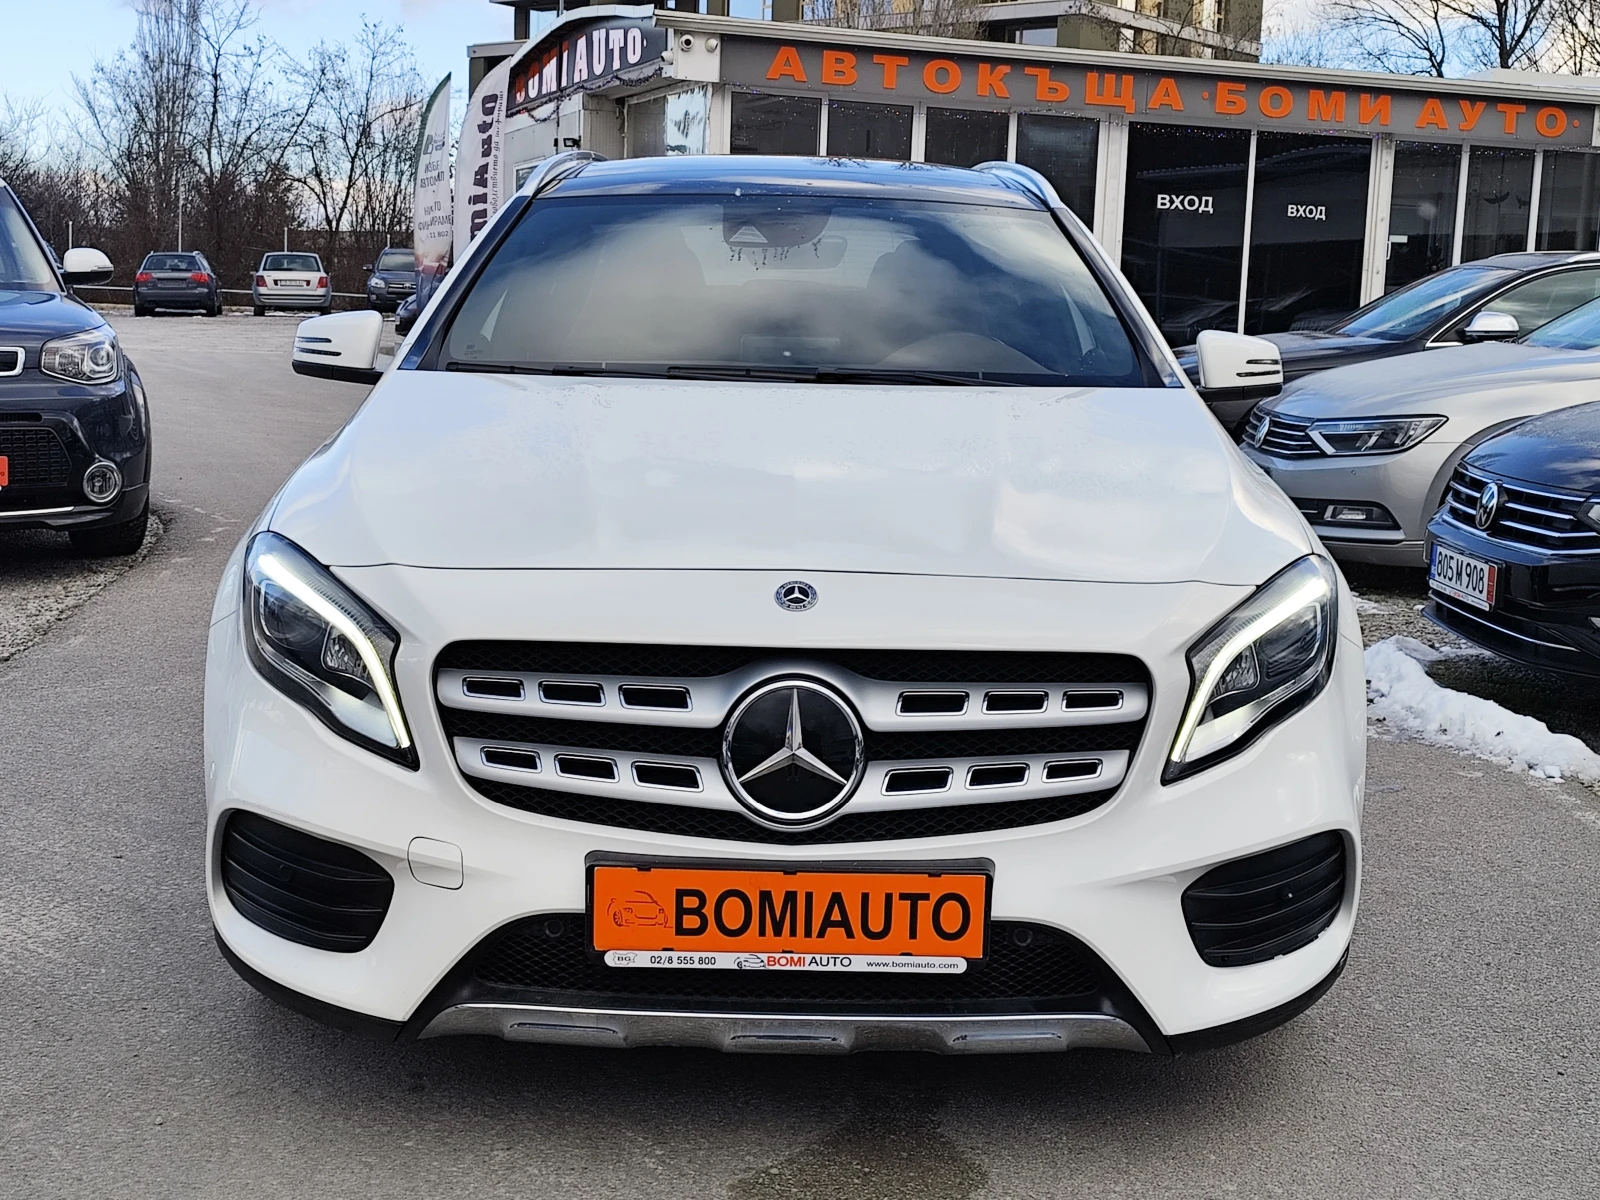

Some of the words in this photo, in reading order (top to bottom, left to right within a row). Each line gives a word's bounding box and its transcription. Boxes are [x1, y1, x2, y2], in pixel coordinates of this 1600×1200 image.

[766, 46, 1185, 114] АВТОКЪЩА
[1214, 81, 1391, 126] БОМИ
[1415, 98, 1568, 138] АУТО
[1157, 194, 1214, 214] ВХОД
[1287, 204, 1326, 221] ВХОД
[1436, 551, 1454, 582] 805
[1455, 558, 1463, 586] M
[1465, 562, 1485, 594] 908
[674, 888, 971, 942] BOMIAUTO
[650, 955, 673, 965] 02/8
[677, 956, 695, 965] 555
[698, 956, 716, 966] 800
[767, 956, 806, 969] BOMI
[808, 956, 852, 968] AUTO
[866, 959, 959, 969] www.bomiauto.com
